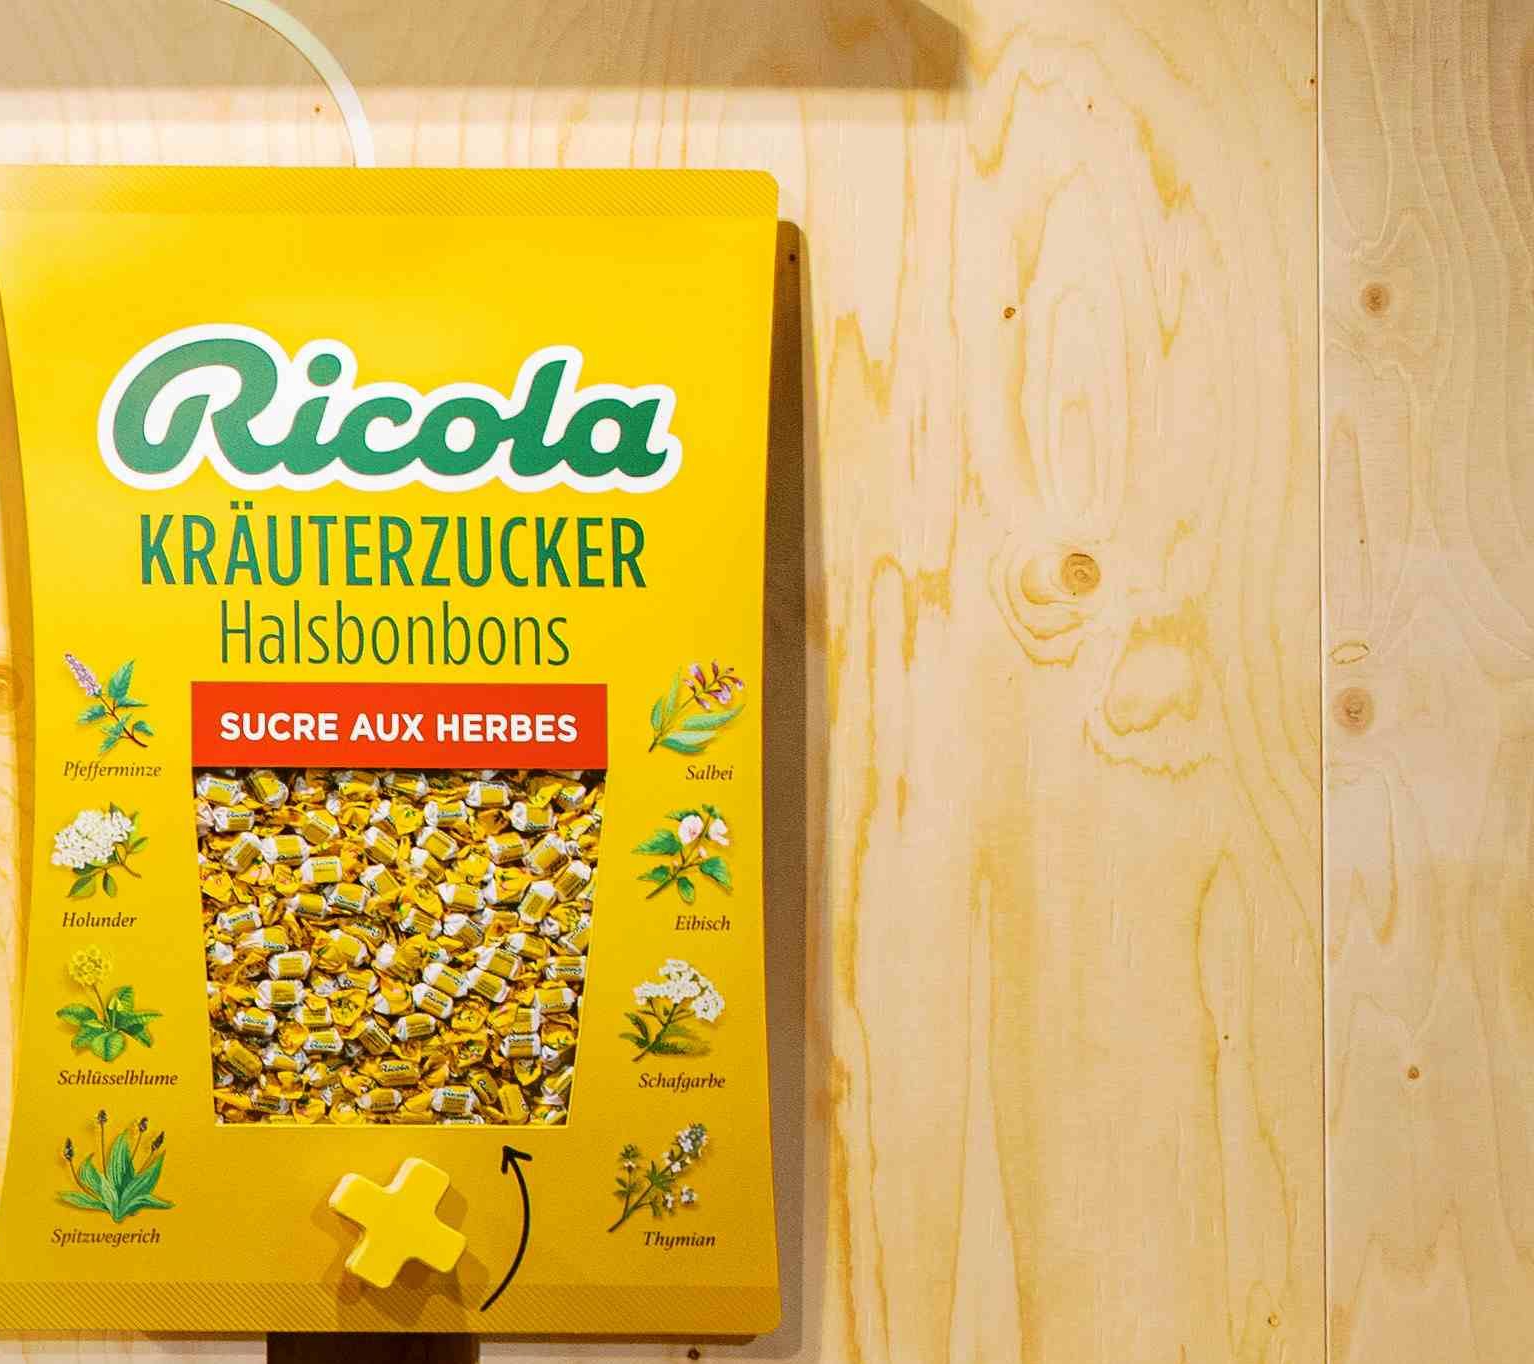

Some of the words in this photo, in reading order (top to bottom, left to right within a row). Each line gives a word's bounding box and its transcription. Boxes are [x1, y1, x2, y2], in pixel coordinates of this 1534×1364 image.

[113, 338, 667, 478] Ricola
[140, 501, 647, 588] KRÄUTERZUCKER
[221, 600, 569, 666] Halsbonbons
[220, 712, 338, 742] SUCRE
[350, 713, 424, 742] AUX
[437, 713, 578, 744] HERBES
[63, 760, 162, 782] Pfefferminze
[686, 765, 734, 780] Salbei
[62, 912, 137, 928] Holunder
[675, 915, 731, 931] Eibisch
[57, 1070, 178, 1085] Schlüsselblume
[638, 1072, 726, 1093] Schafgarbe
[51, 1228, 161, 1248] Spitzwegerich
[644, 1232, 717, 1251] Thymian
